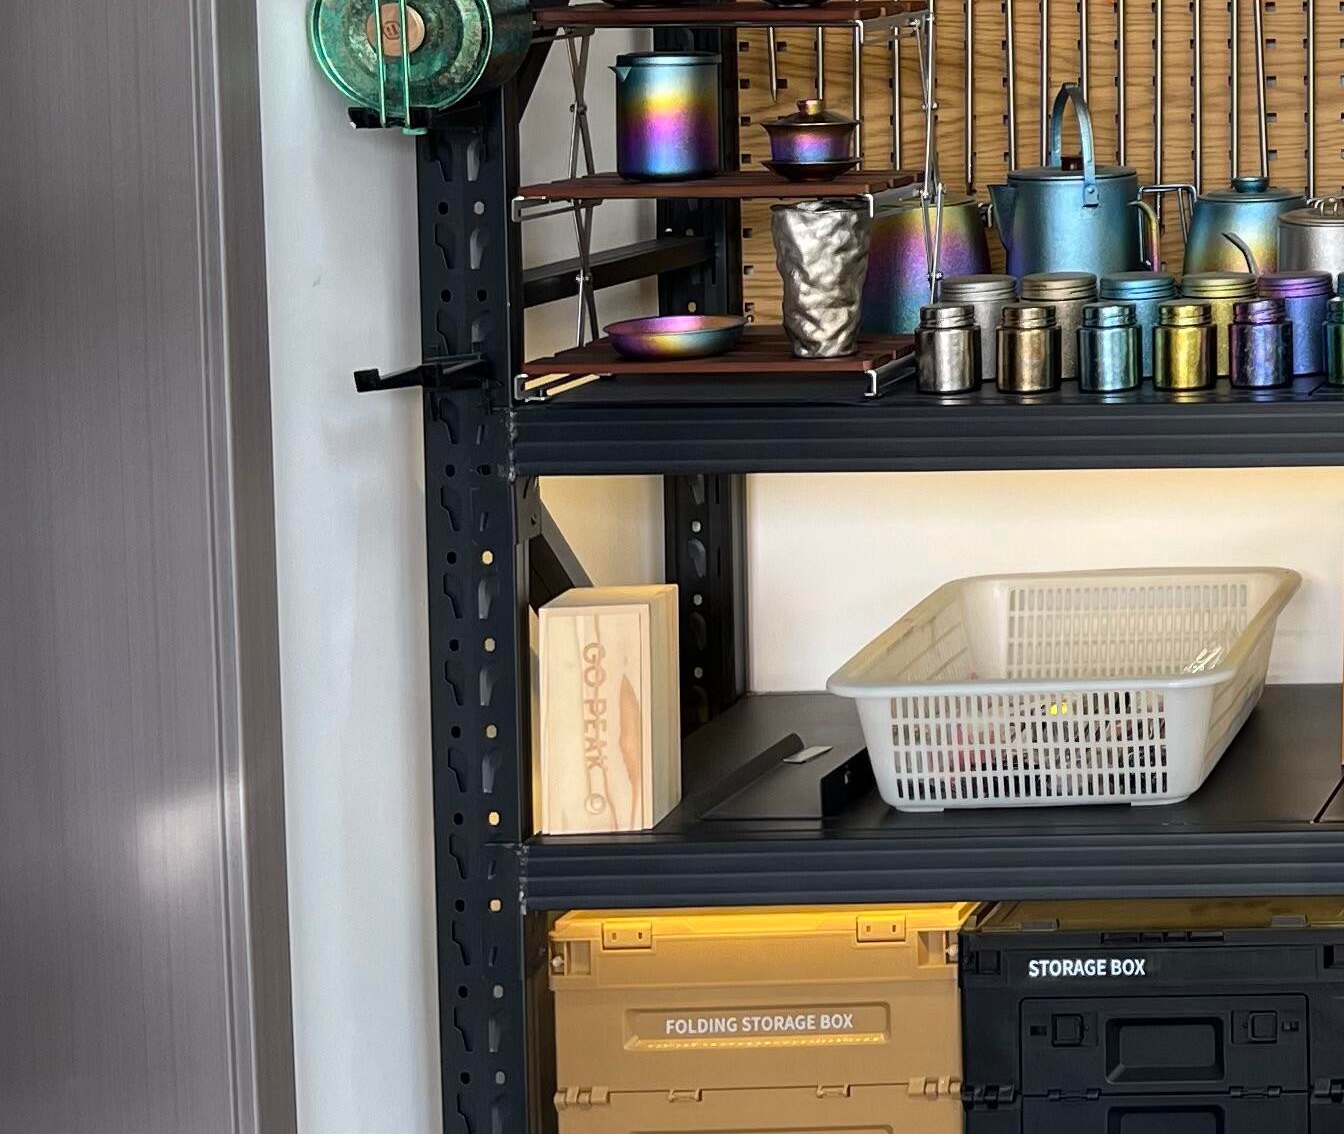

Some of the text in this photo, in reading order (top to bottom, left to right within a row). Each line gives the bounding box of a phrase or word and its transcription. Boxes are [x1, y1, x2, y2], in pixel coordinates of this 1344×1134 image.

[583, 642, 608, 771] GO PEAK
[1028, 958, 1146, 978] STORAGE BOX
[665, 1014, 854, 1035] FOLDING STORAGE BOX
